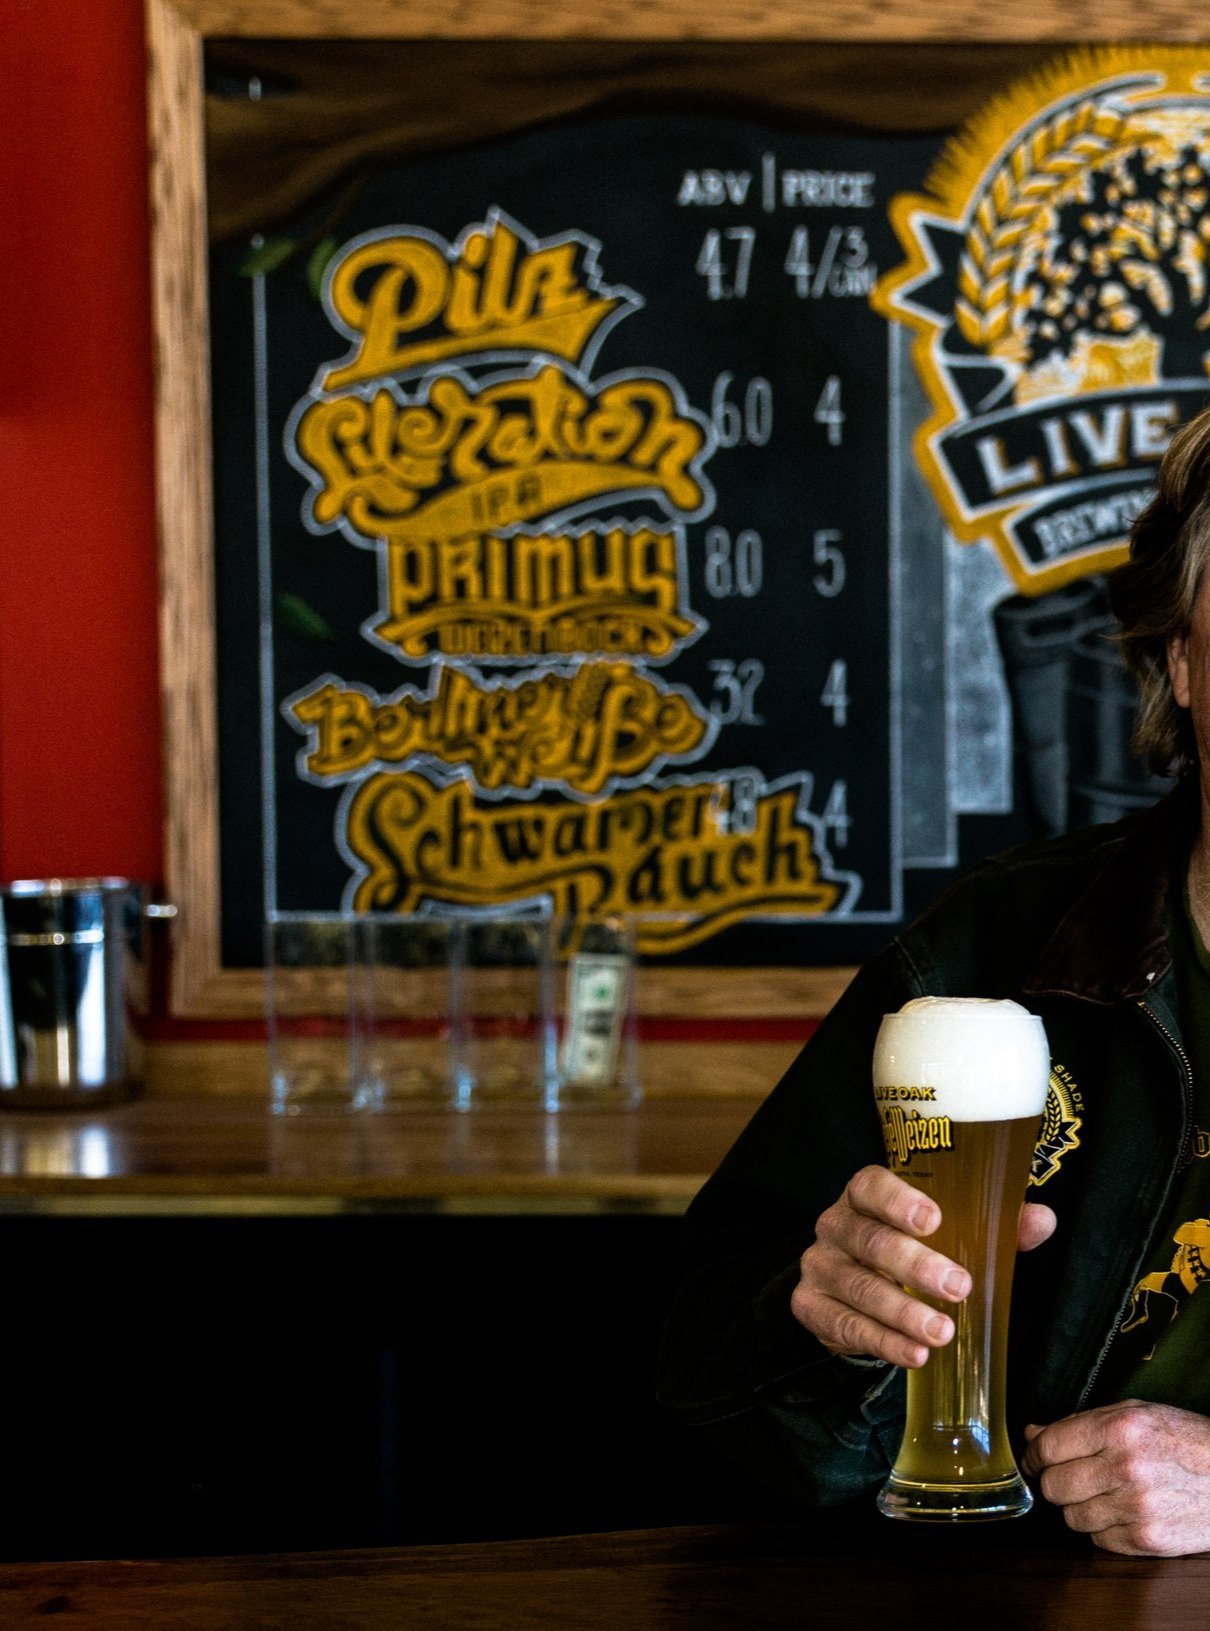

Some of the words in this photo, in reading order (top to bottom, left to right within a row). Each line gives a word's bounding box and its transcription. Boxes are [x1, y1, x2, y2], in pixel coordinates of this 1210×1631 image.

[678, 169, 752, 207] ABV
[782, 169, 877, 207] PRICE
[815, 375, 845, 447] 4
[977, 401, 1177, 495] LIVE
[1033, 487, 1160, 558] BREWIN
[813, 529, 845, 598] 5
[820, 658, 850, 727] 4
[821, 779, 851, 848] 4
[1053, 1064, 1085, 1112] SHADE
